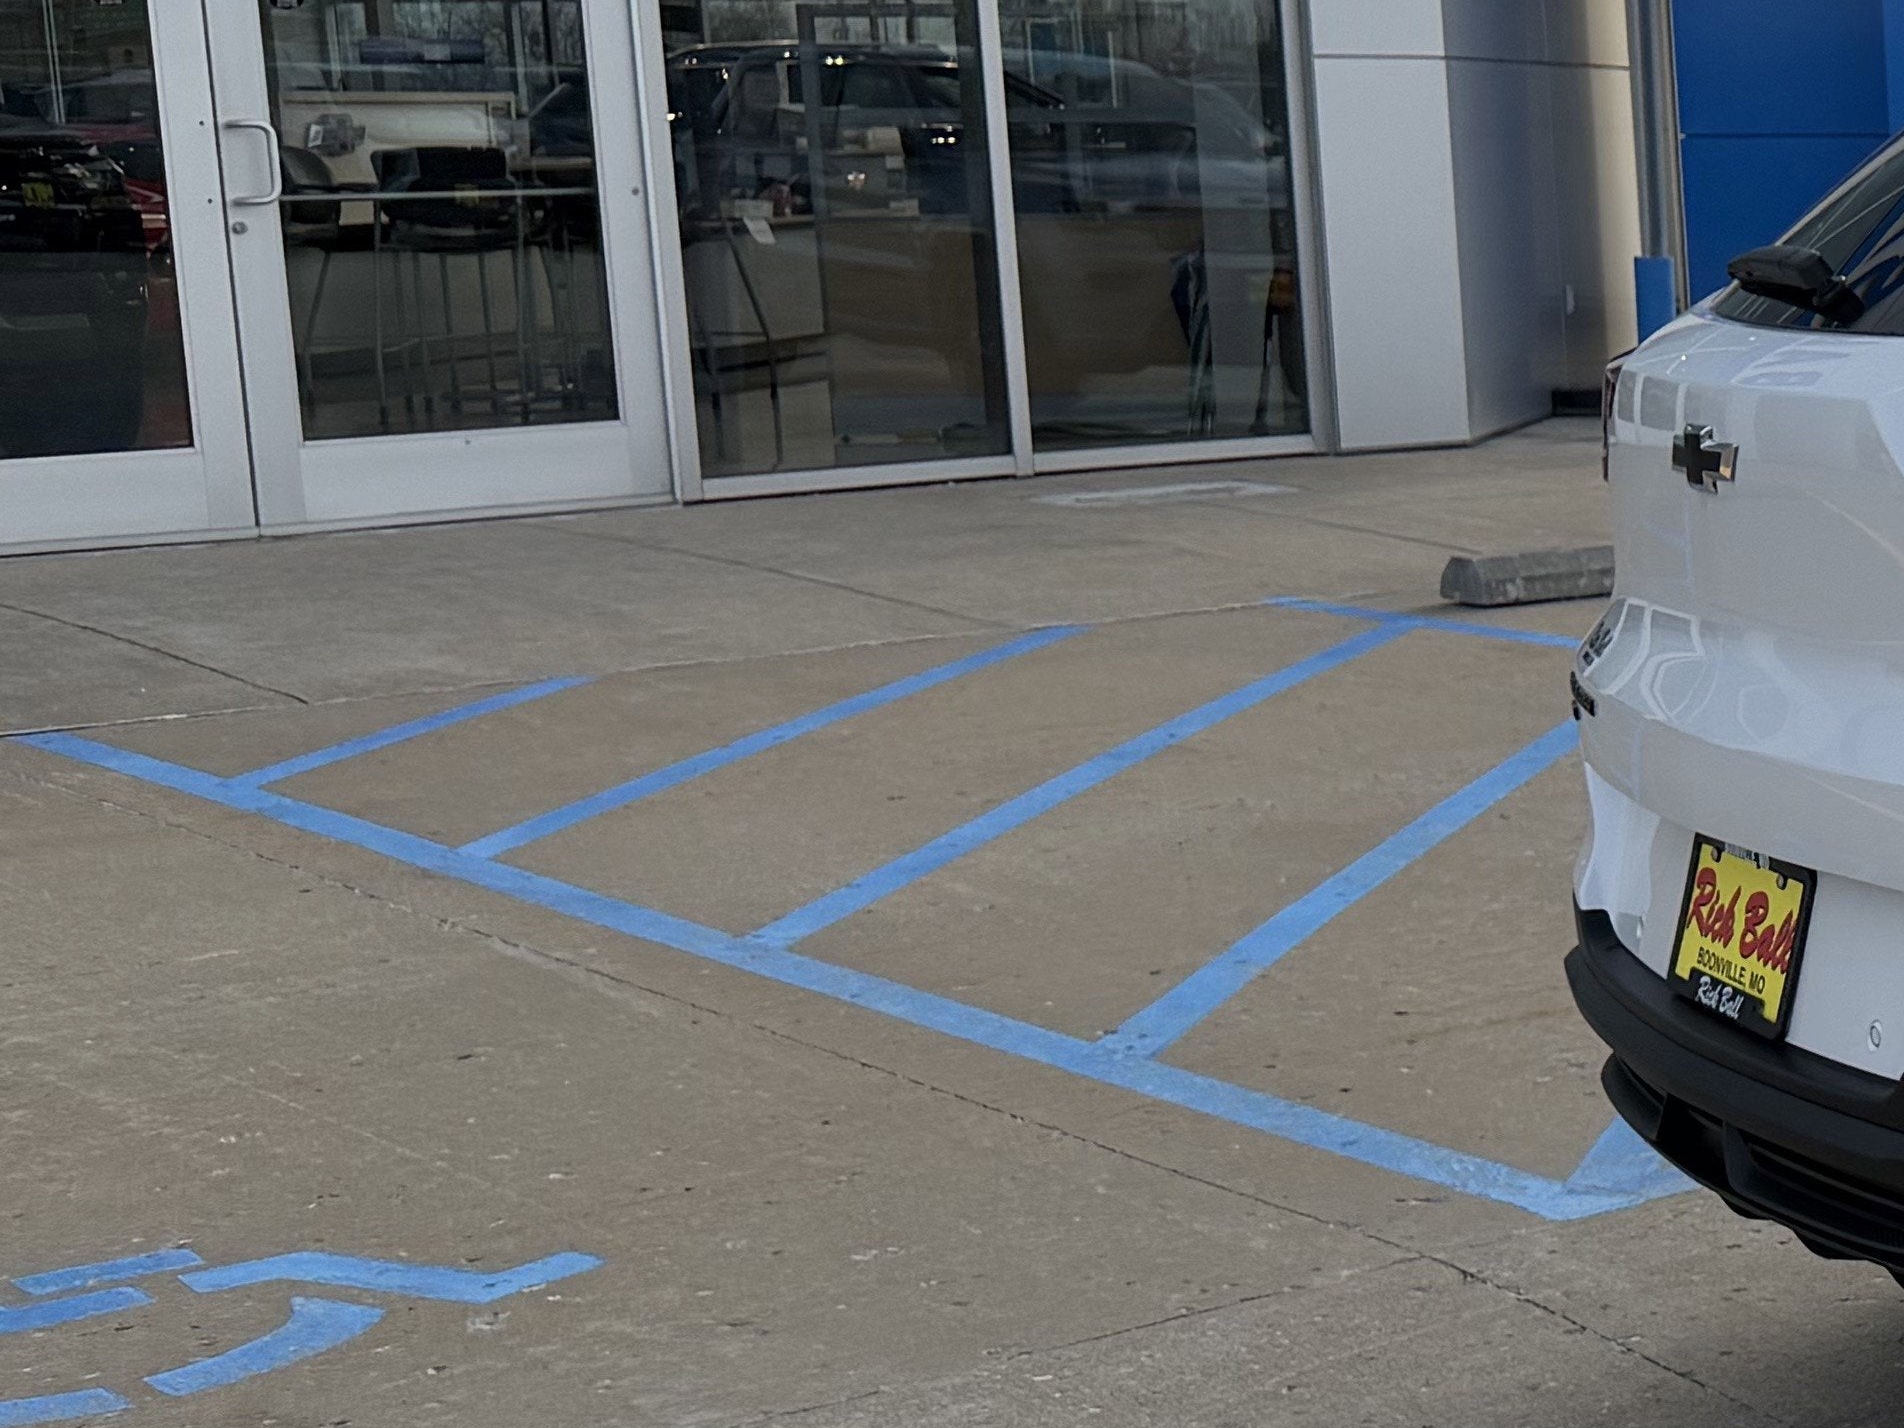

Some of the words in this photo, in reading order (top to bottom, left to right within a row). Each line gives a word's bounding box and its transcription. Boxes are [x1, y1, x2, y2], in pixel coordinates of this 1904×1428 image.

[1686, 867, 1742, 949] Rick
[1739, 890, 1797, 975] Ball
[1694, 974, 1722, 1010] Rick
[1718, 985, 1745, 1020] Ball
[1748, 970, 1766, 996] MO
